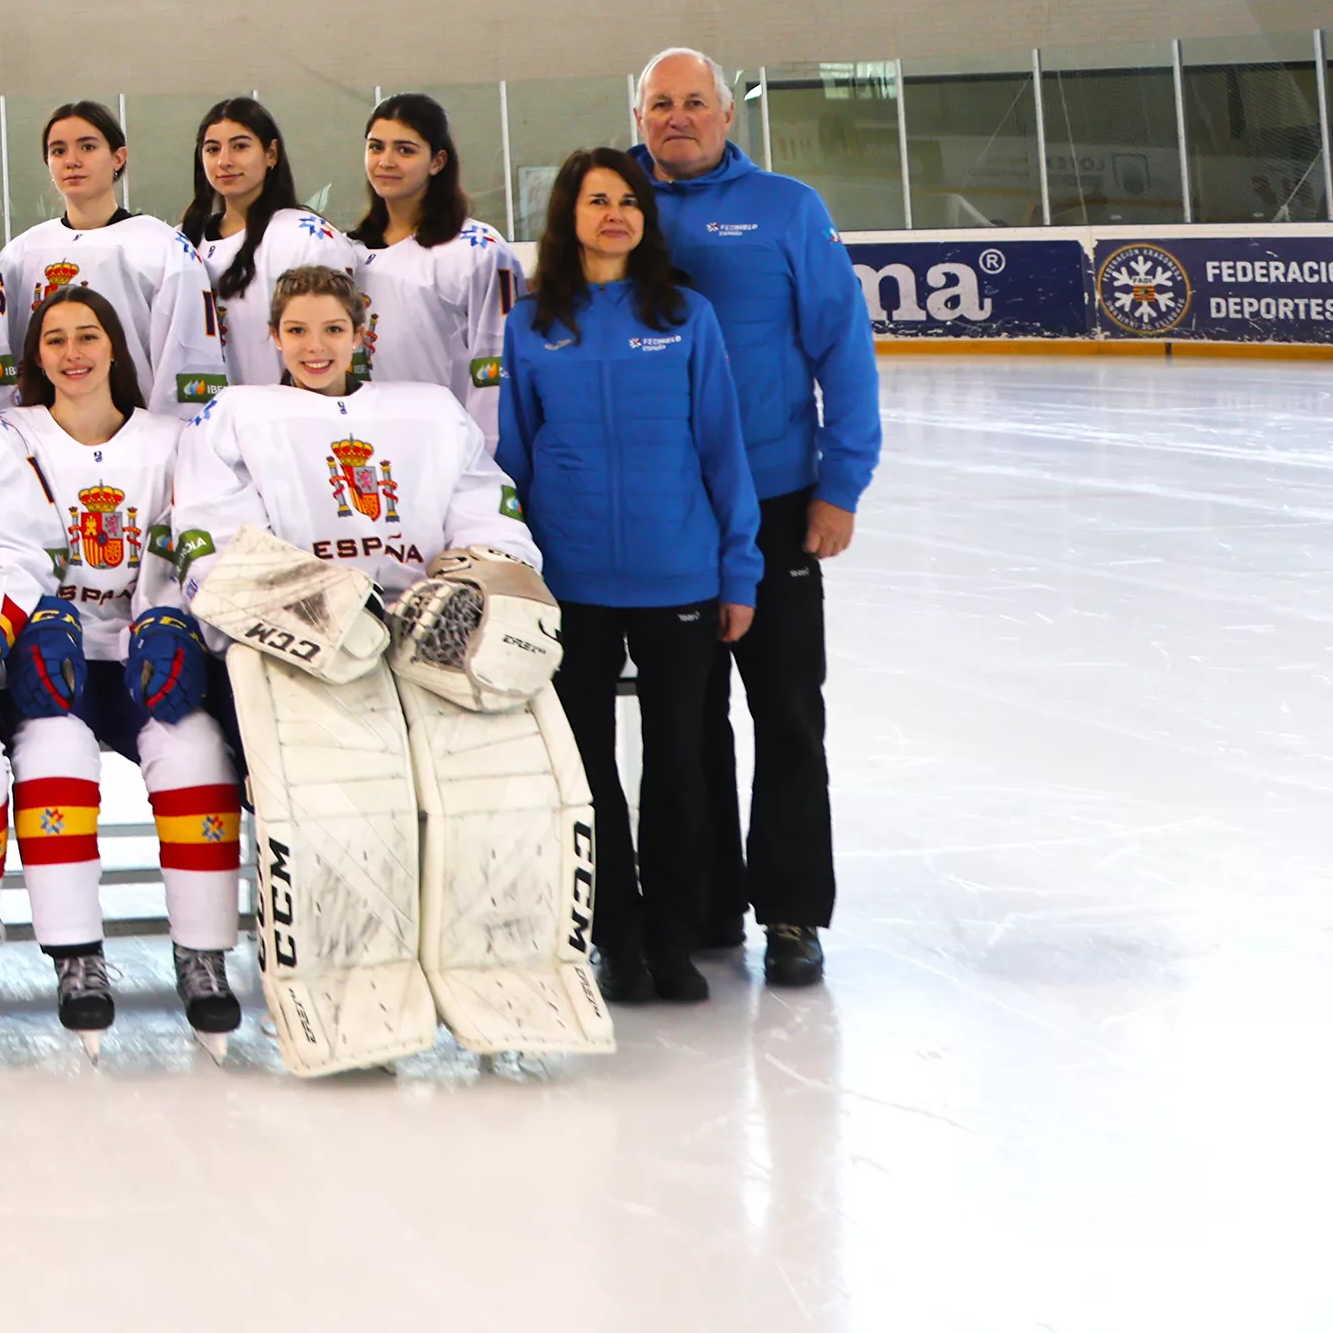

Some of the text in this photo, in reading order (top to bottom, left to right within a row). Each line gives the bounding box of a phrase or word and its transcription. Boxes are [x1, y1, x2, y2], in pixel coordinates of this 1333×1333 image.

[852, 262, 993, 321] ma
[313, 534, 425, 565] ESPÑA
[244, 622, 321, 663] CCM
[268, 836, 298, 969] CCM
[568, 821, 592, 955] CCM
